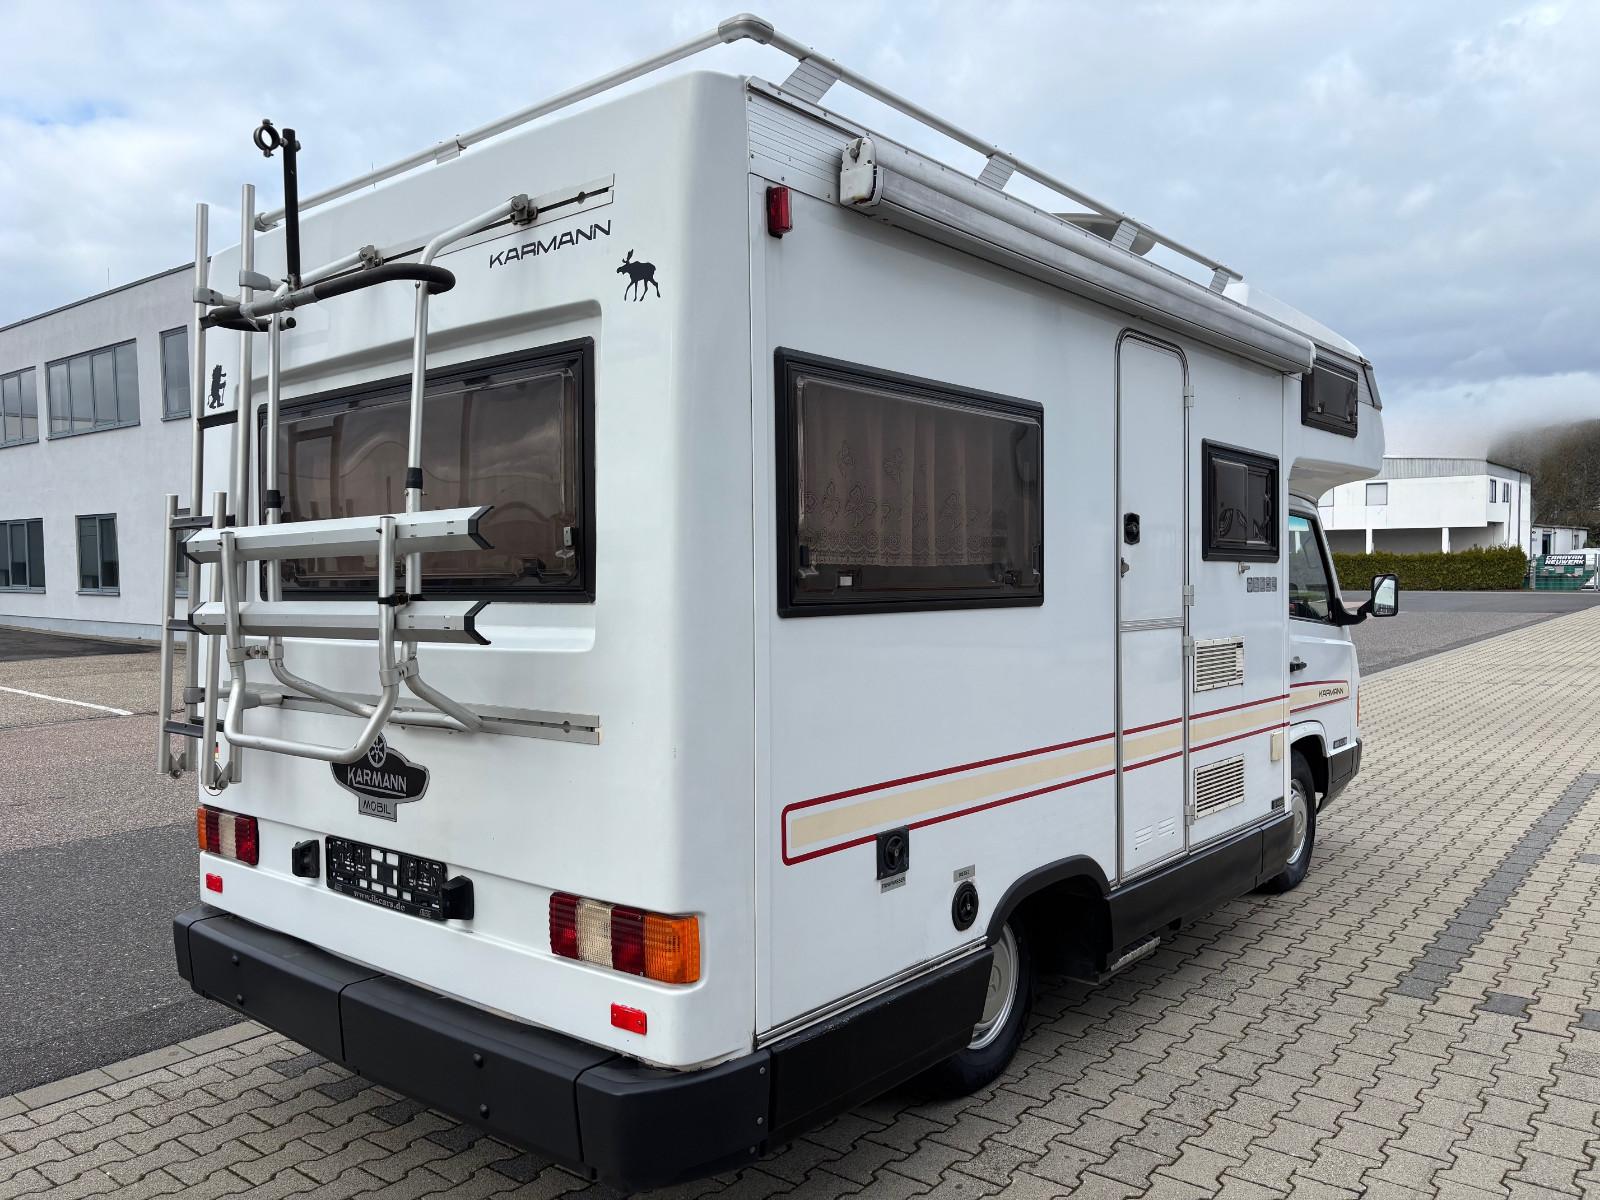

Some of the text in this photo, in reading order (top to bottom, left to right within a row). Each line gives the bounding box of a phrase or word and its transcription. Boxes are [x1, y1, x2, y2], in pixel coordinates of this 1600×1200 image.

[489, 220, 611, 269] KARMANN
[1319, 687, 1344, 697] KARMANN
[347, 765, 407, 793] KARMANN
[362, 800, 392, 815] MOBIL
